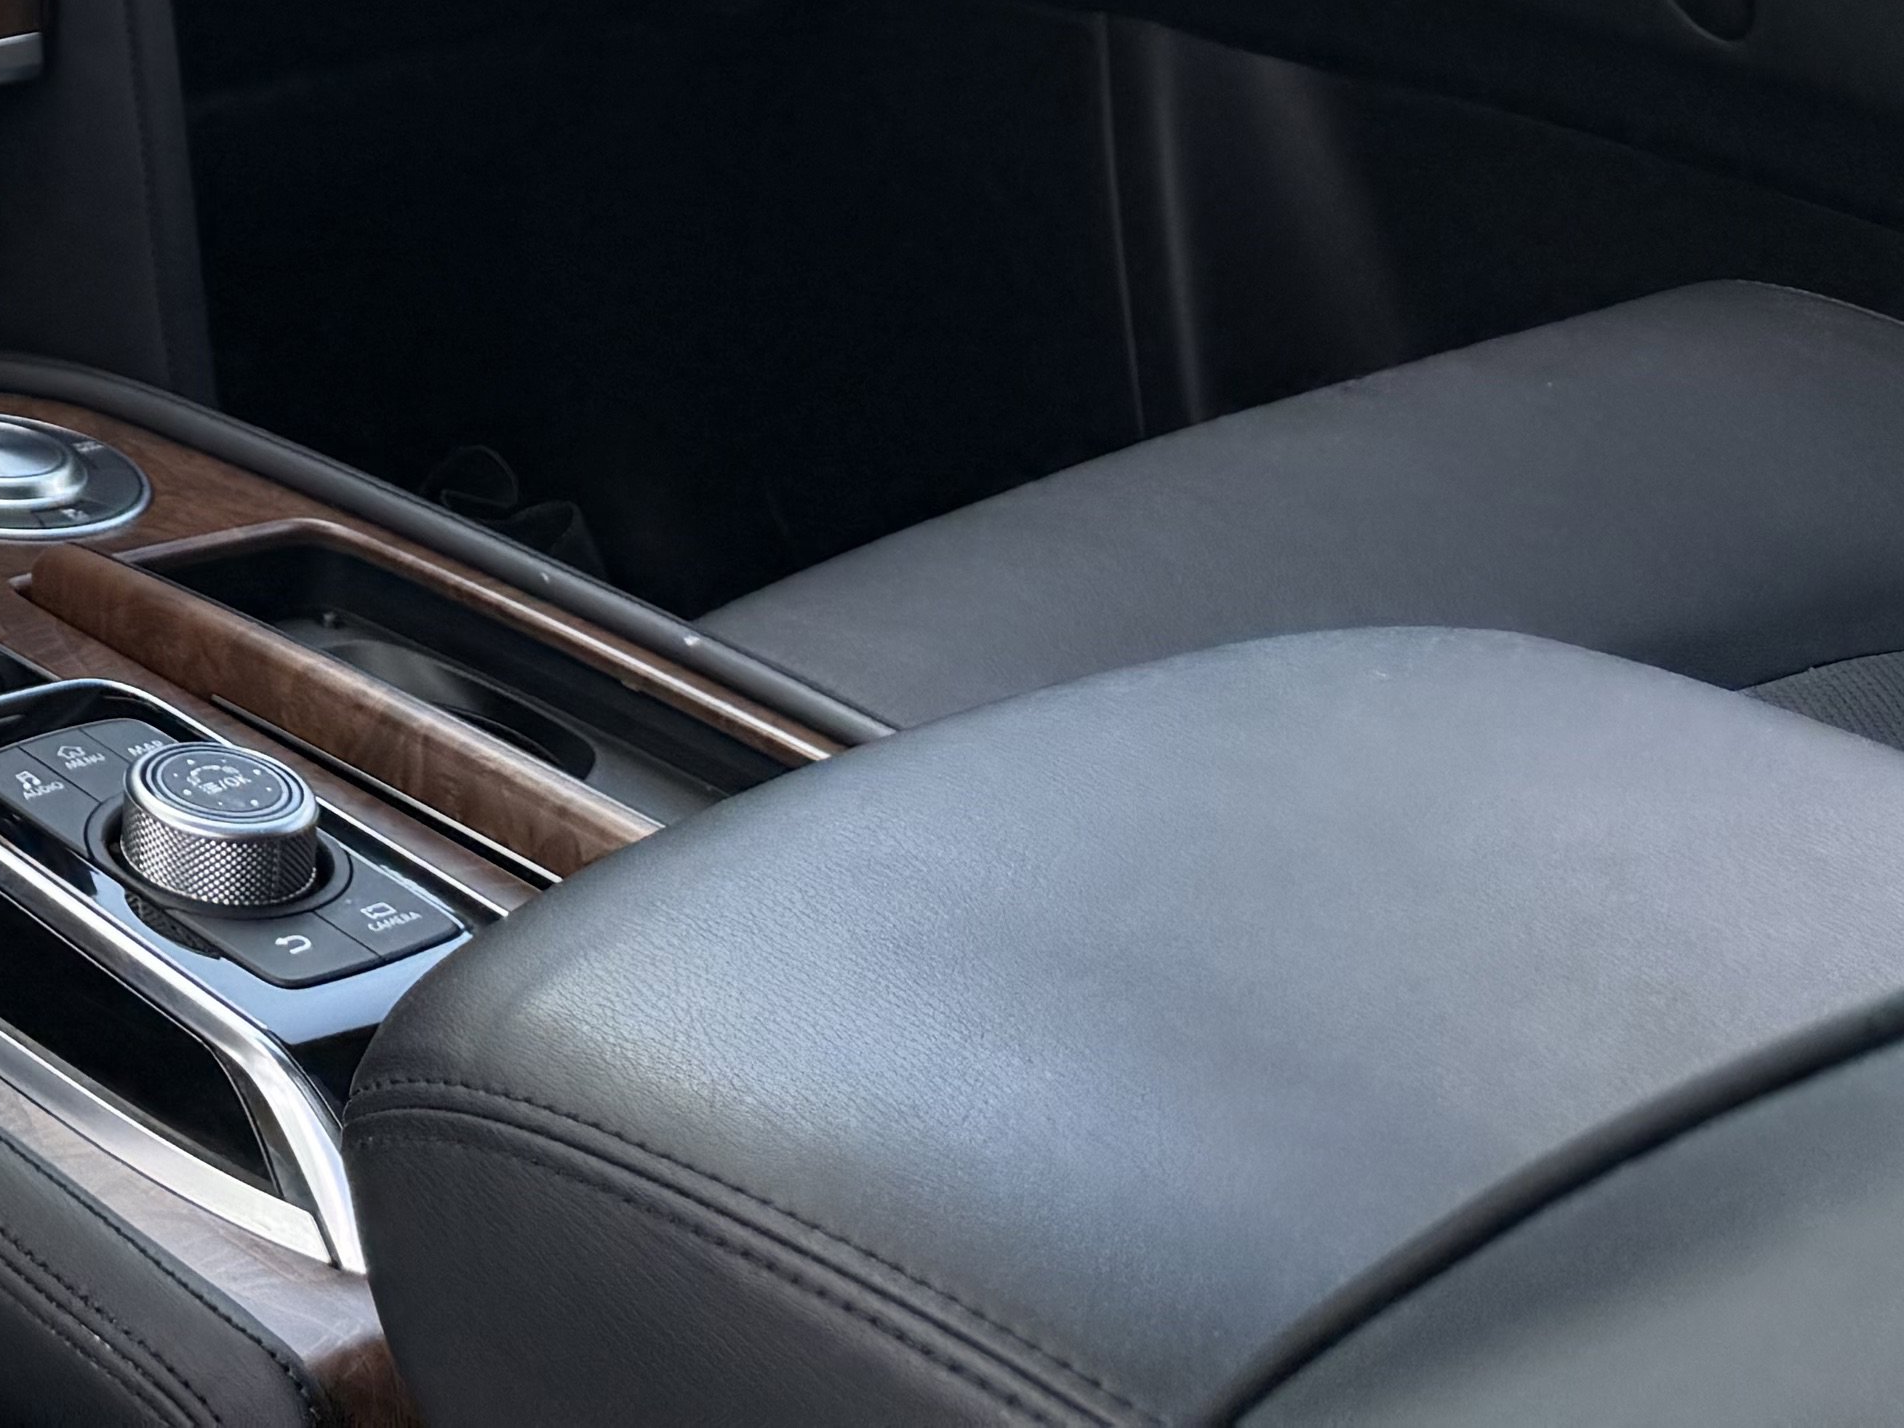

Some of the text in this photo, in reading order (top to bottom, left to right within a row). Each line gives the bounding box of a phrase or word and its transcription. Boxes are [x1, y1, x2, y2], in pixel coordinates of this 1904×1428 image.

[65, 752, 106, 771] MENU
[22, 781, 65, 801] AUDIO
[367, 910, 423, 933] CAMERA
